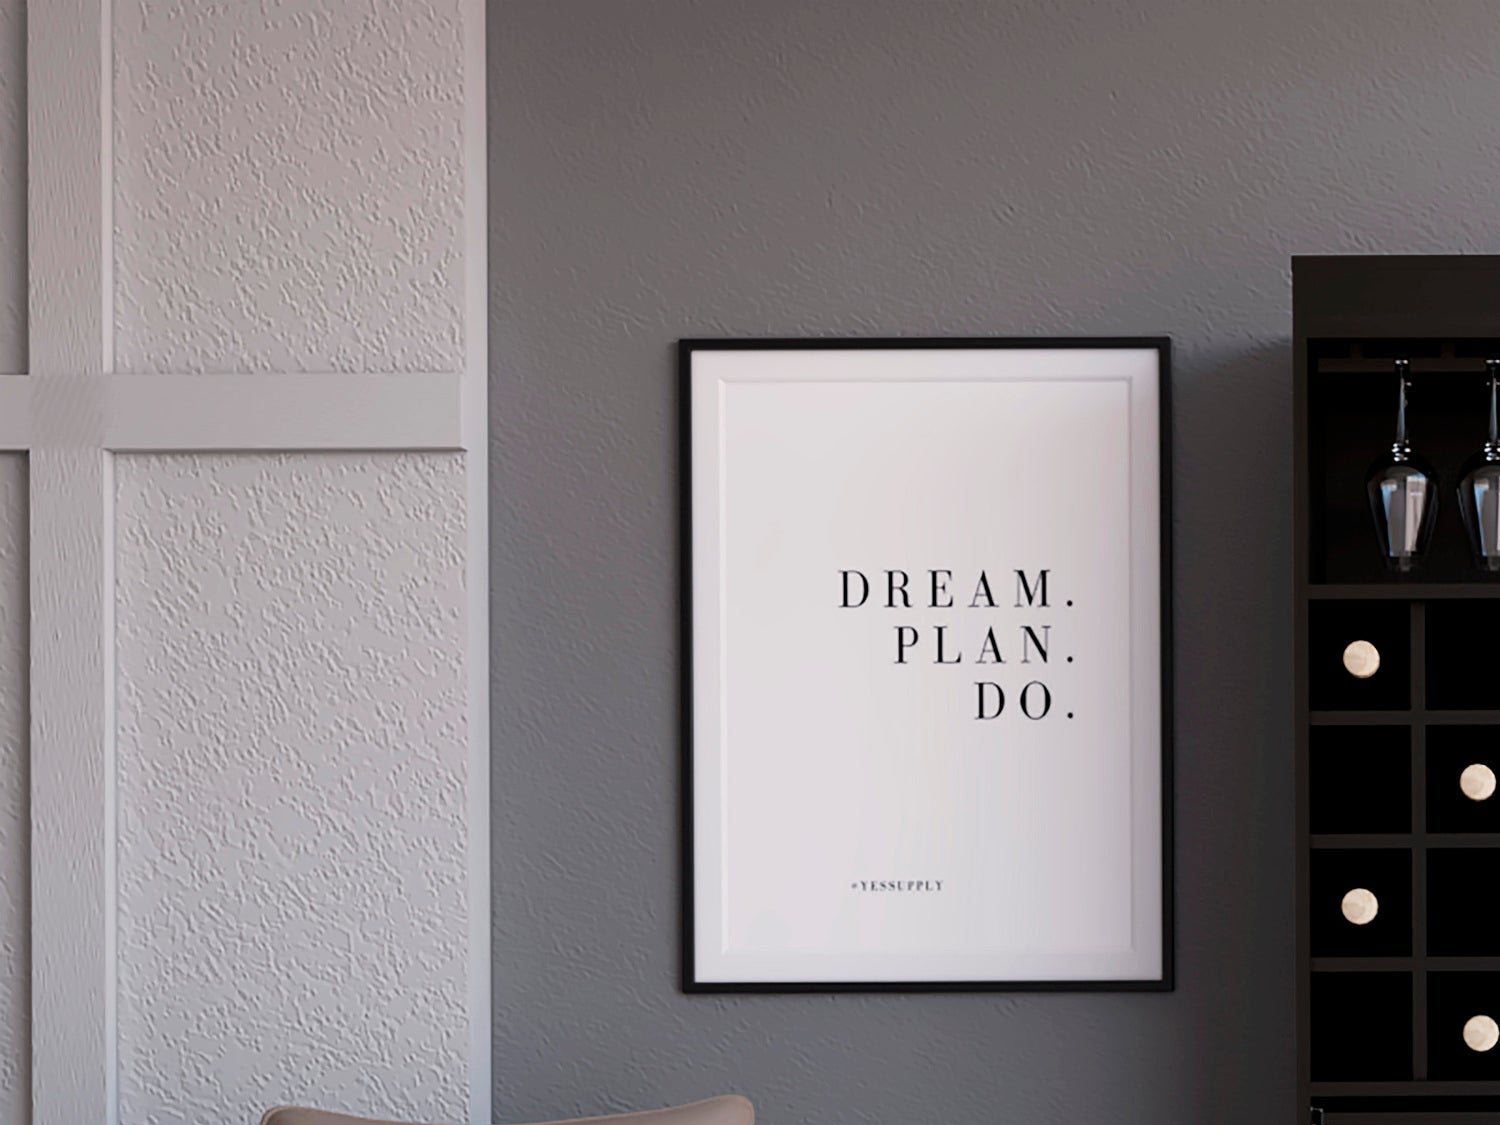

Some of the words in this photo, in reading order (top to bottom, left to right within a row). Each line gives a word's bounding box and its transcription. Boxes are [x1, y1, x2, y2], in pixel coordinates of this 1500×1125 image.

[838, 569, 1075, 609] DREAM.
[893, 625, 1075, 665] PLAN.
[973, 680, 1075, 721] DO.
